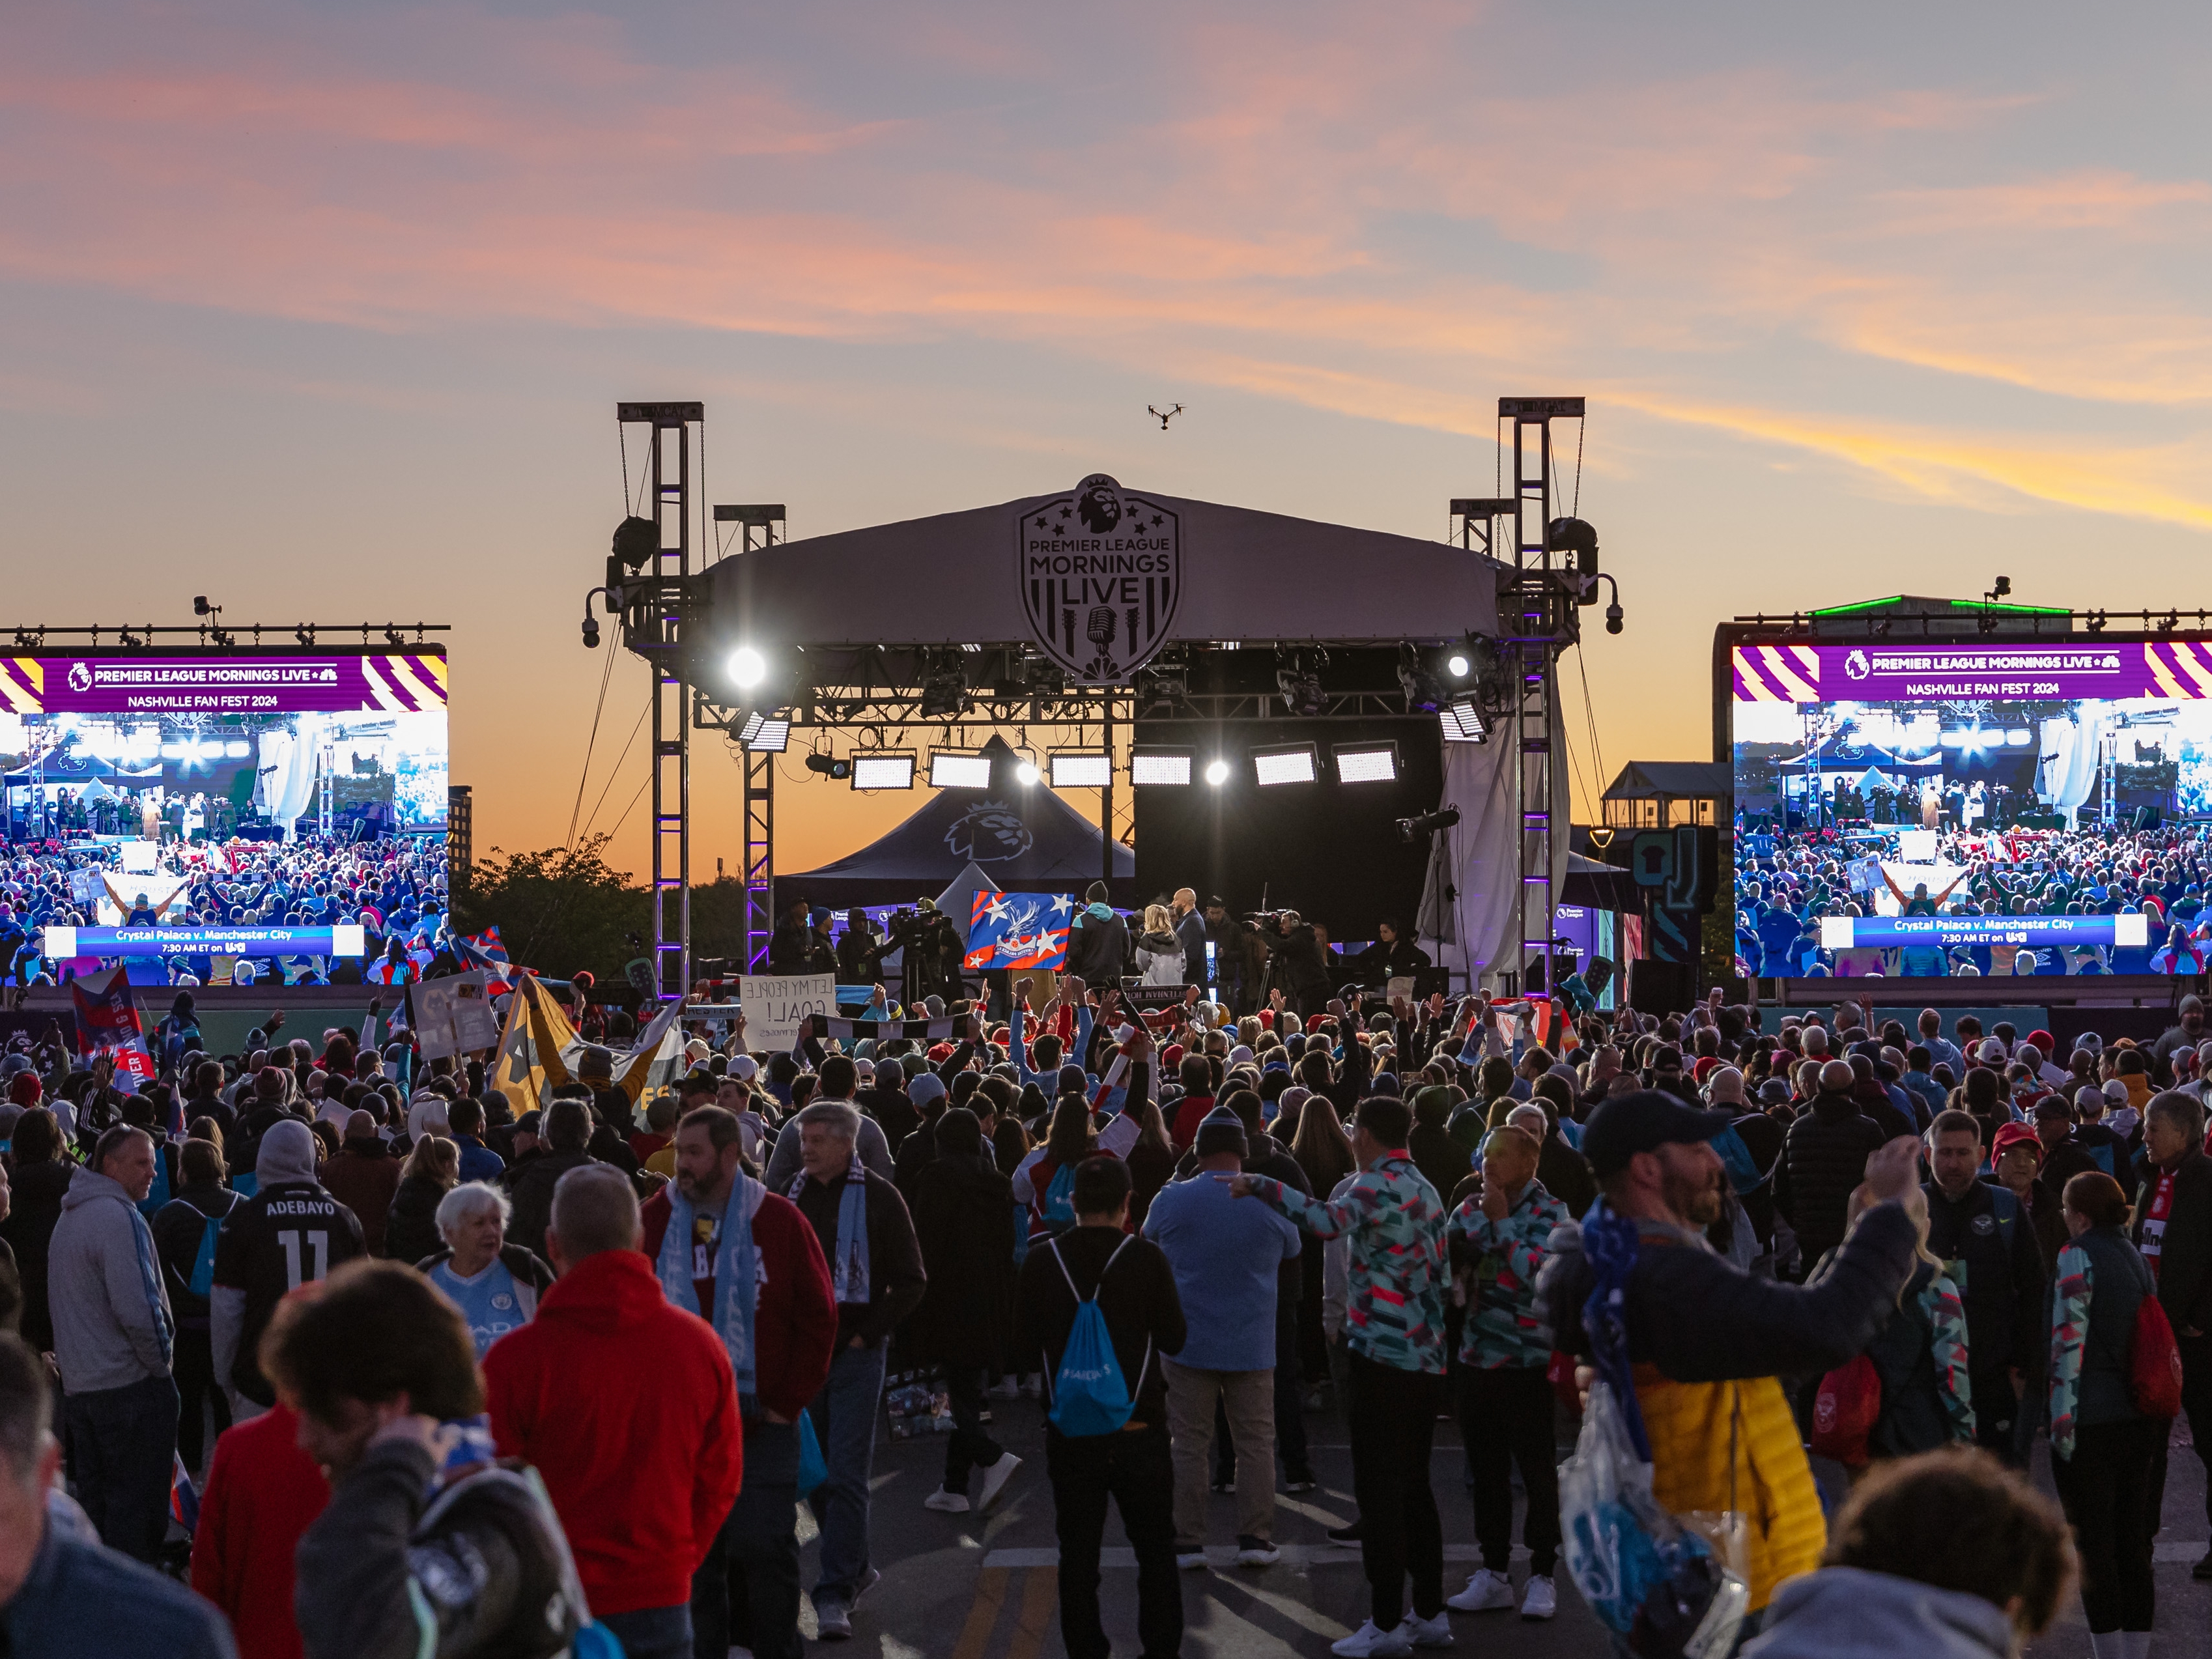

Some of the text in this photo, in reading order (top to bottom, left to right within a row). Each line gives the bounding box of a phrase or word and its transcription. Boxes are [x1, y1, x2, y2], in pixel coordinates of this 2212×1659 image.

[1030, 538, 1170, 552] PREMIER LEAGUE
[1030, 554, 1170, 574] MORNINGS
[1062, 577, 1140, 604] LIVE
[1873, 656, 2092, 670] PREMIER LEAGUE MORNINGS LIVE
[95, 669, 310, 682] PREMIER LEAGUE MORNINGS LIVE
[1907, 683, 2060, 695] NASHVILLE FAN FEST 2024
[128, 695, 278, 707] NASHVILLE FAN FEST 2024
[1894, 920, 1934, 932] Crystal
[1936, 920, 1972, 931] Palace
[1985, 919, 2050, 930] Manchester
[2052, 918, 2074, 931] City
[116, 930, 154, 941] Crystal
[158, 930, 191, 941] Palace
[205, 930, 268, 940] Manchester
[270, 929, 292, 941] City
[1942, 934, 1961, 943] 7:30
[1963, 934, 1977, 943] AM
[1979, 934, 1990, 943] ET
[162, 944, 181, 953] 7:30
[183, 944, 197, 953] AM
[198, 944, 210, 952] ET
[109, 991, 124, 1014] SEA
[115, 1014, 129, 1024] &
[120, 1025, 137, 1055] LAND
[267, 1200, 335, 1216] ADEBAYO
[277, 1230, 328, 1290] 11
